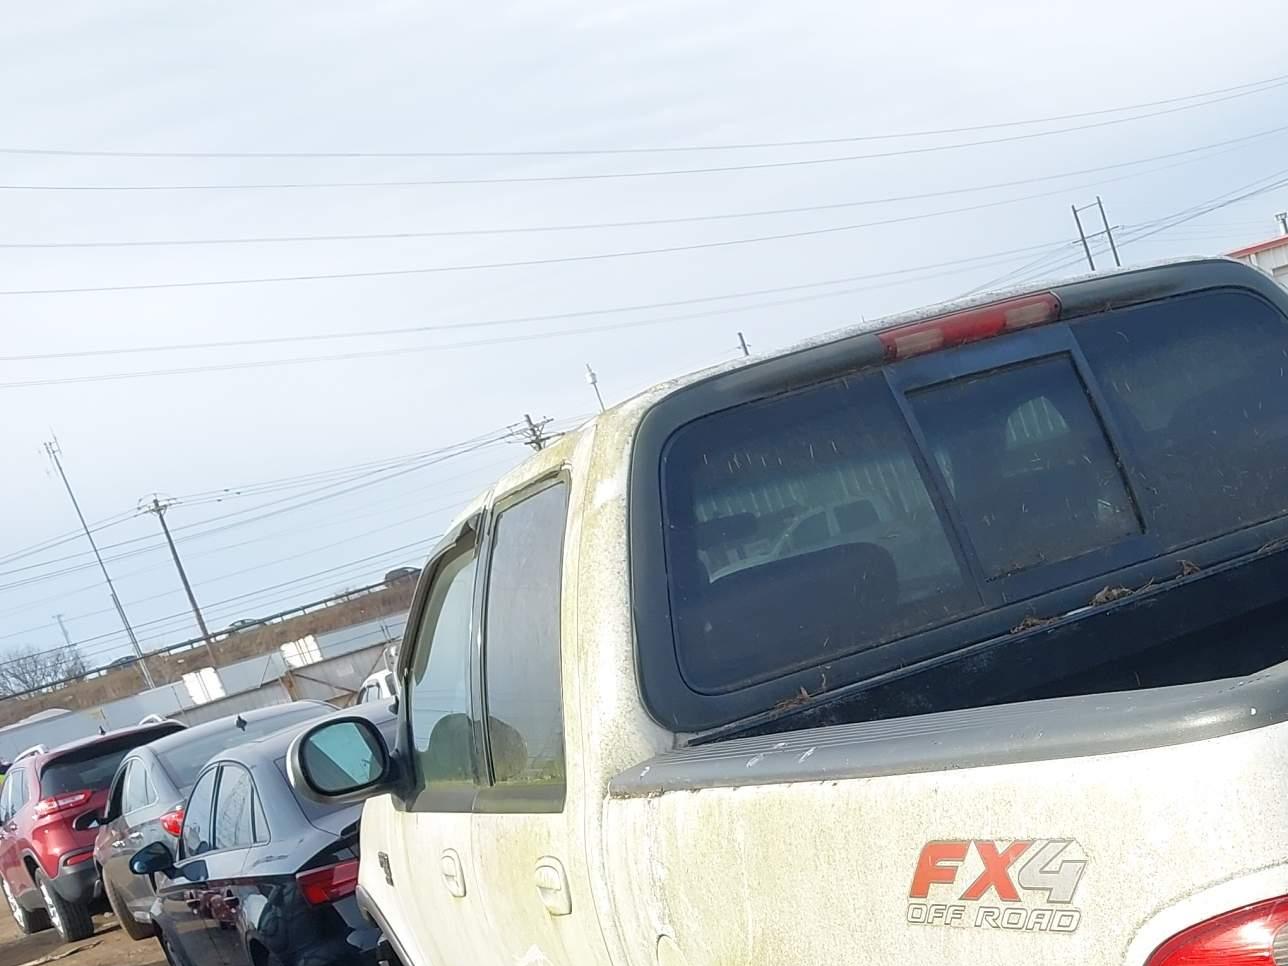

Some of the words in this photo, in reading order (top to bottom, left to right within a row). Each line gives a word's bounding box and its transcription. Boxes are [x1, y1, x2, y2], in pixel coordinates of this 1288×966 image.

[908, 838, 1089, 904] FX4
[906, 902, 966, 926] OFF
[974, 905, 1082, 933] ROAD
